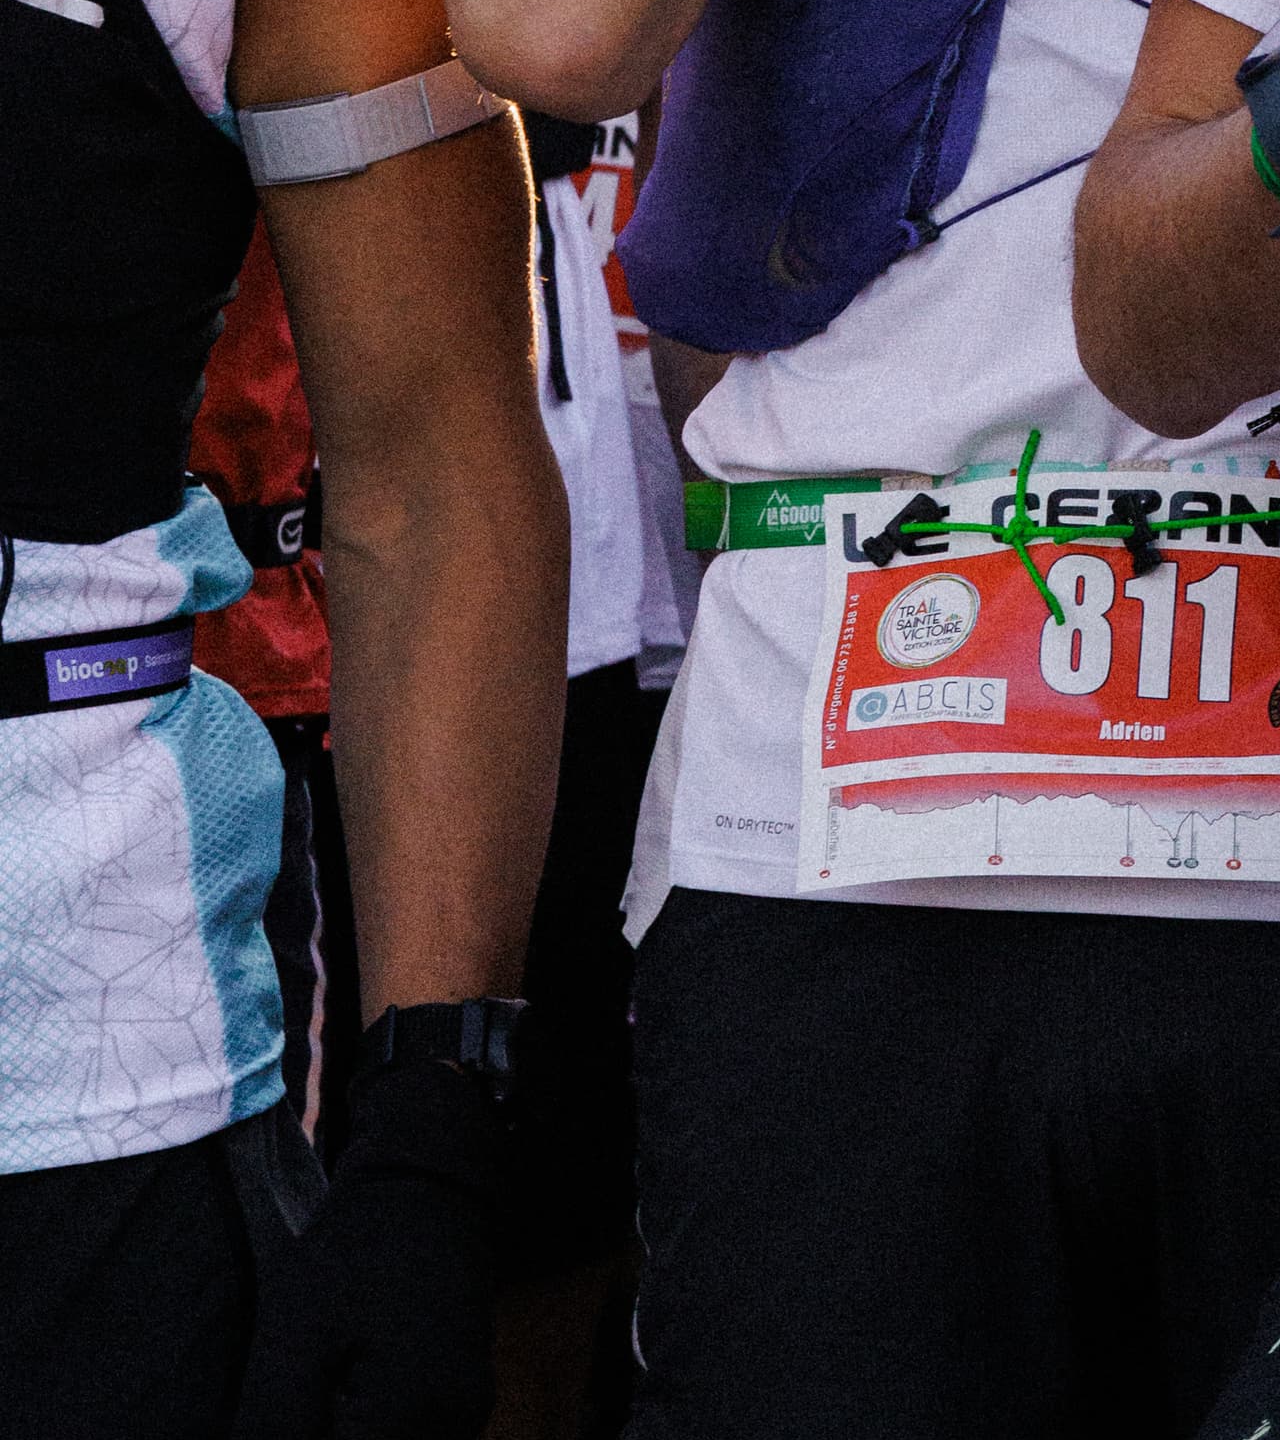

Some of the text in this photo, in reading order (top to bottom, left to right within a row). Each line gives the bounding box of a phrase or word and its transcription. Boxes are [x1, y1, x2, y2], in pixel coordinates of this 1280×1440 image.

[780, 503, 825, 525] 6000
[849, 594, 861, 608] 14
[899, 597, 942, 619] TRAIL
[846, 611, 858, 624] 88
[896, 612, 942, 631] SAINTE
[1038, 552, 1240, 703] 811
[843, 627, 855, 641] 53
[902, 620, 964, 641] VICTOIRE
[839, 643, 851, 658] 73
[836, 658, 848, 673] 06
[825, 675, 846, 732] d'urgence
[892, 681, 996, 714] ABCIS
[1099, 719, 1167, 744] Adrien
[714, 814, 733, 829] ON
